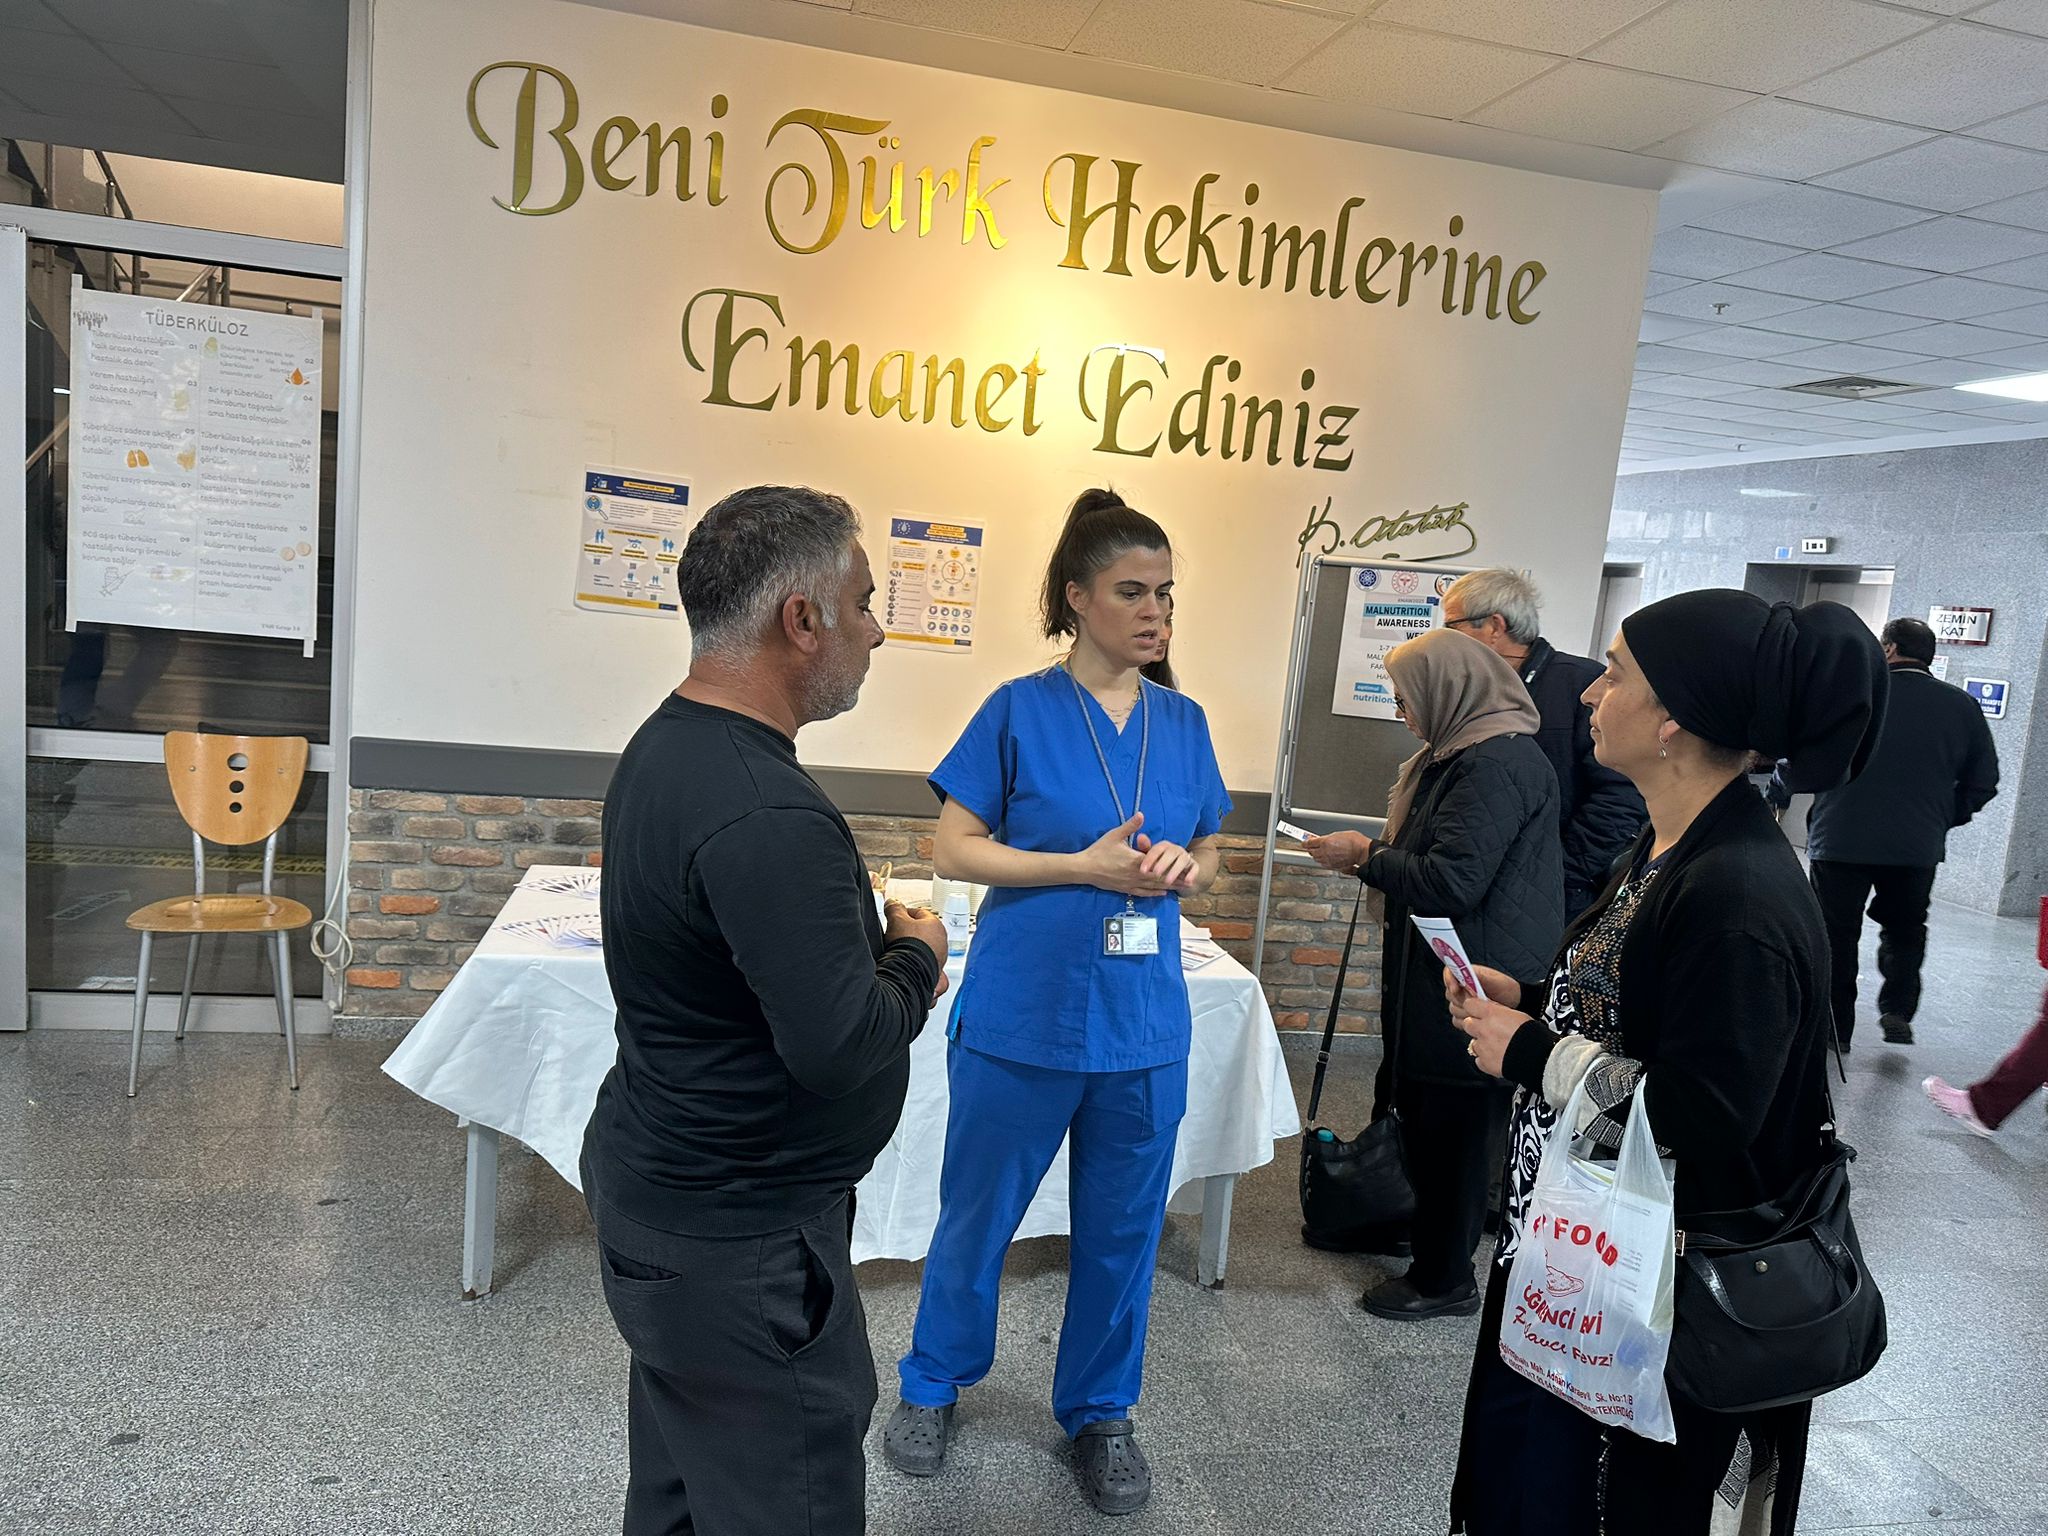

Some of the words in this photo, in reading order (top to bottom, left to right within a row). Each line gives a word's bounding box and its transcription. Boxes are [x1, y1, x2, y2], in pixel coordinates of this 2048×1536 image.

[467, 60, 728, 216] Beni
[765, 108, 1011, 255] Türk
[1043, 152, 1548, 325] Hekimlerine
[146, 309, 248, 336] TÜBERKÜLOZ
[681, 288, 1047, 436] Emanet
[1078, 343, 1361, 471] Ediniz
[1365, 606, 1430, 616] MALNUTRITION
[1936, 613, 1977, 624] ZEMİN
[1377, 619, 1430, 628] AWARENESS
[1941, 626, 1967, 636] KAT
[1572, 1346, 1613, 1367] Fevzi
[1547, 1369, 1566, 1387] Adnan
